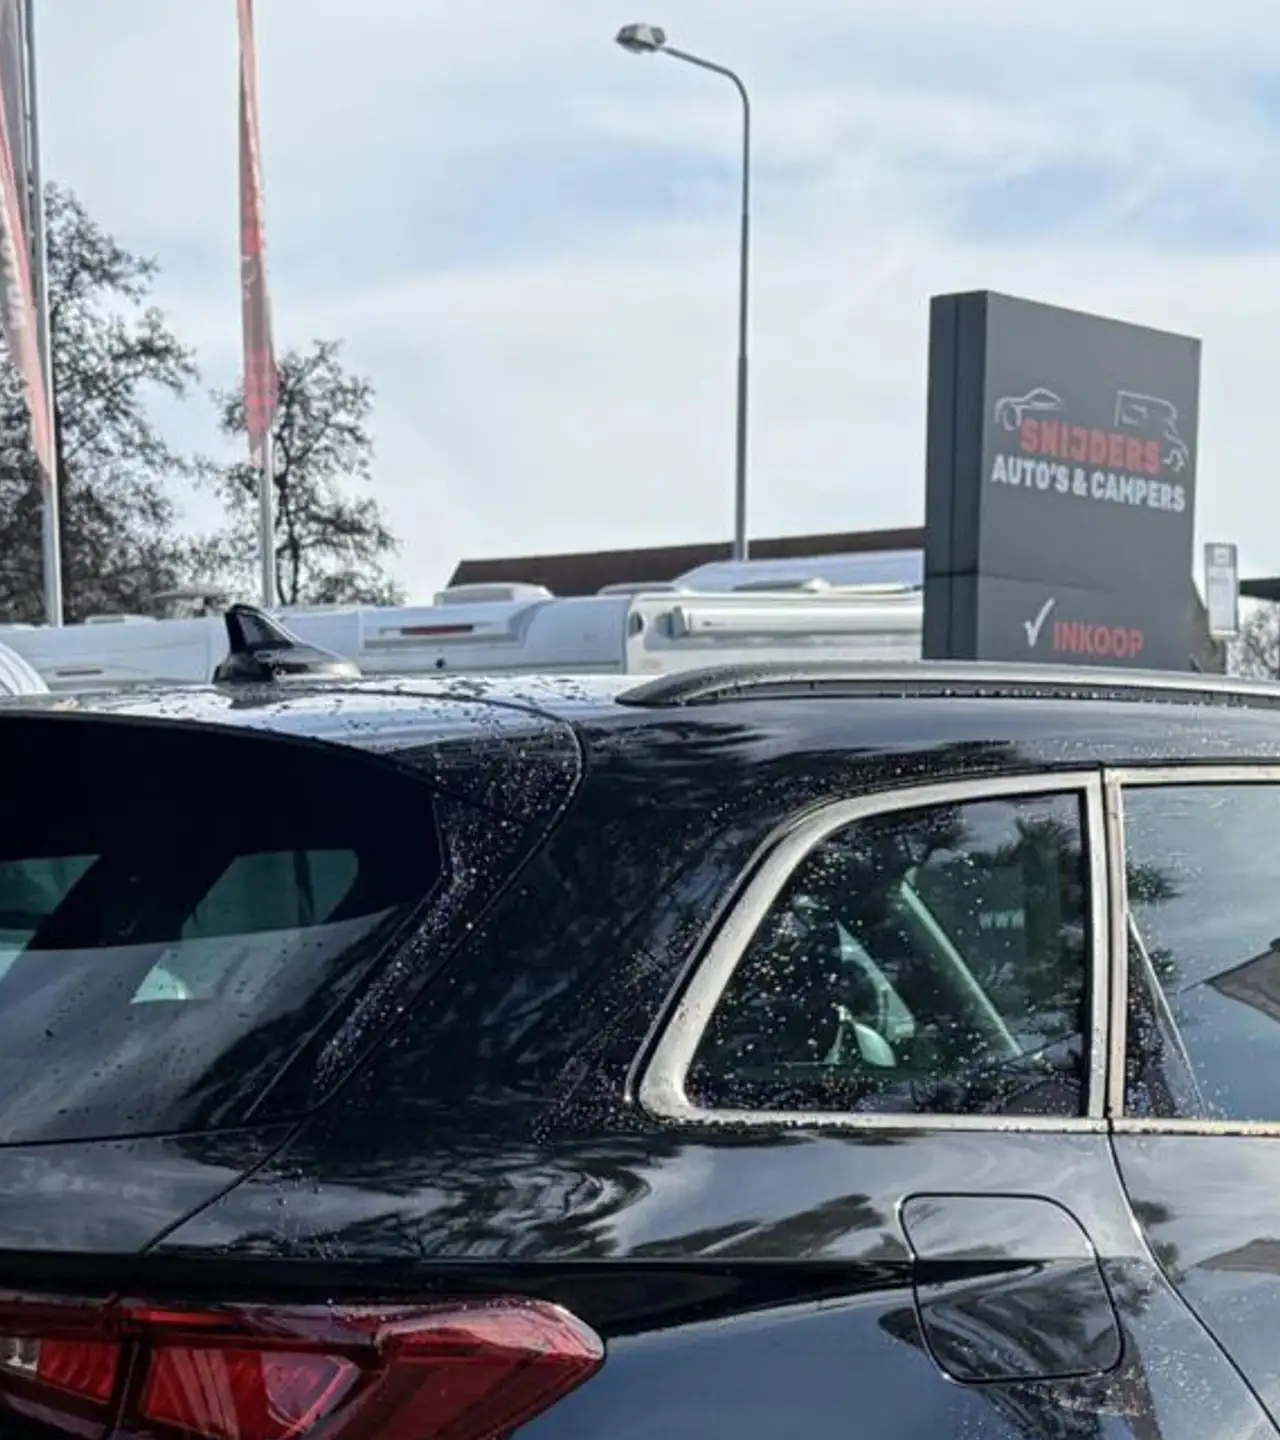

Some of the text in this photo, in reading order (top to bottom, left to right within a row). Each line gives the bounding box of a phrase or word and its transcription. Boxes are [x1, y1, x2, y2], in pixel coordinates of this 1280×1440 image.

[1020, 417, 1161, 475] SNIJDERS
[991, 453, 1186, 512] AUTO'S & CAMPERS
[1053, 620, 1144, 657] INKOOP
